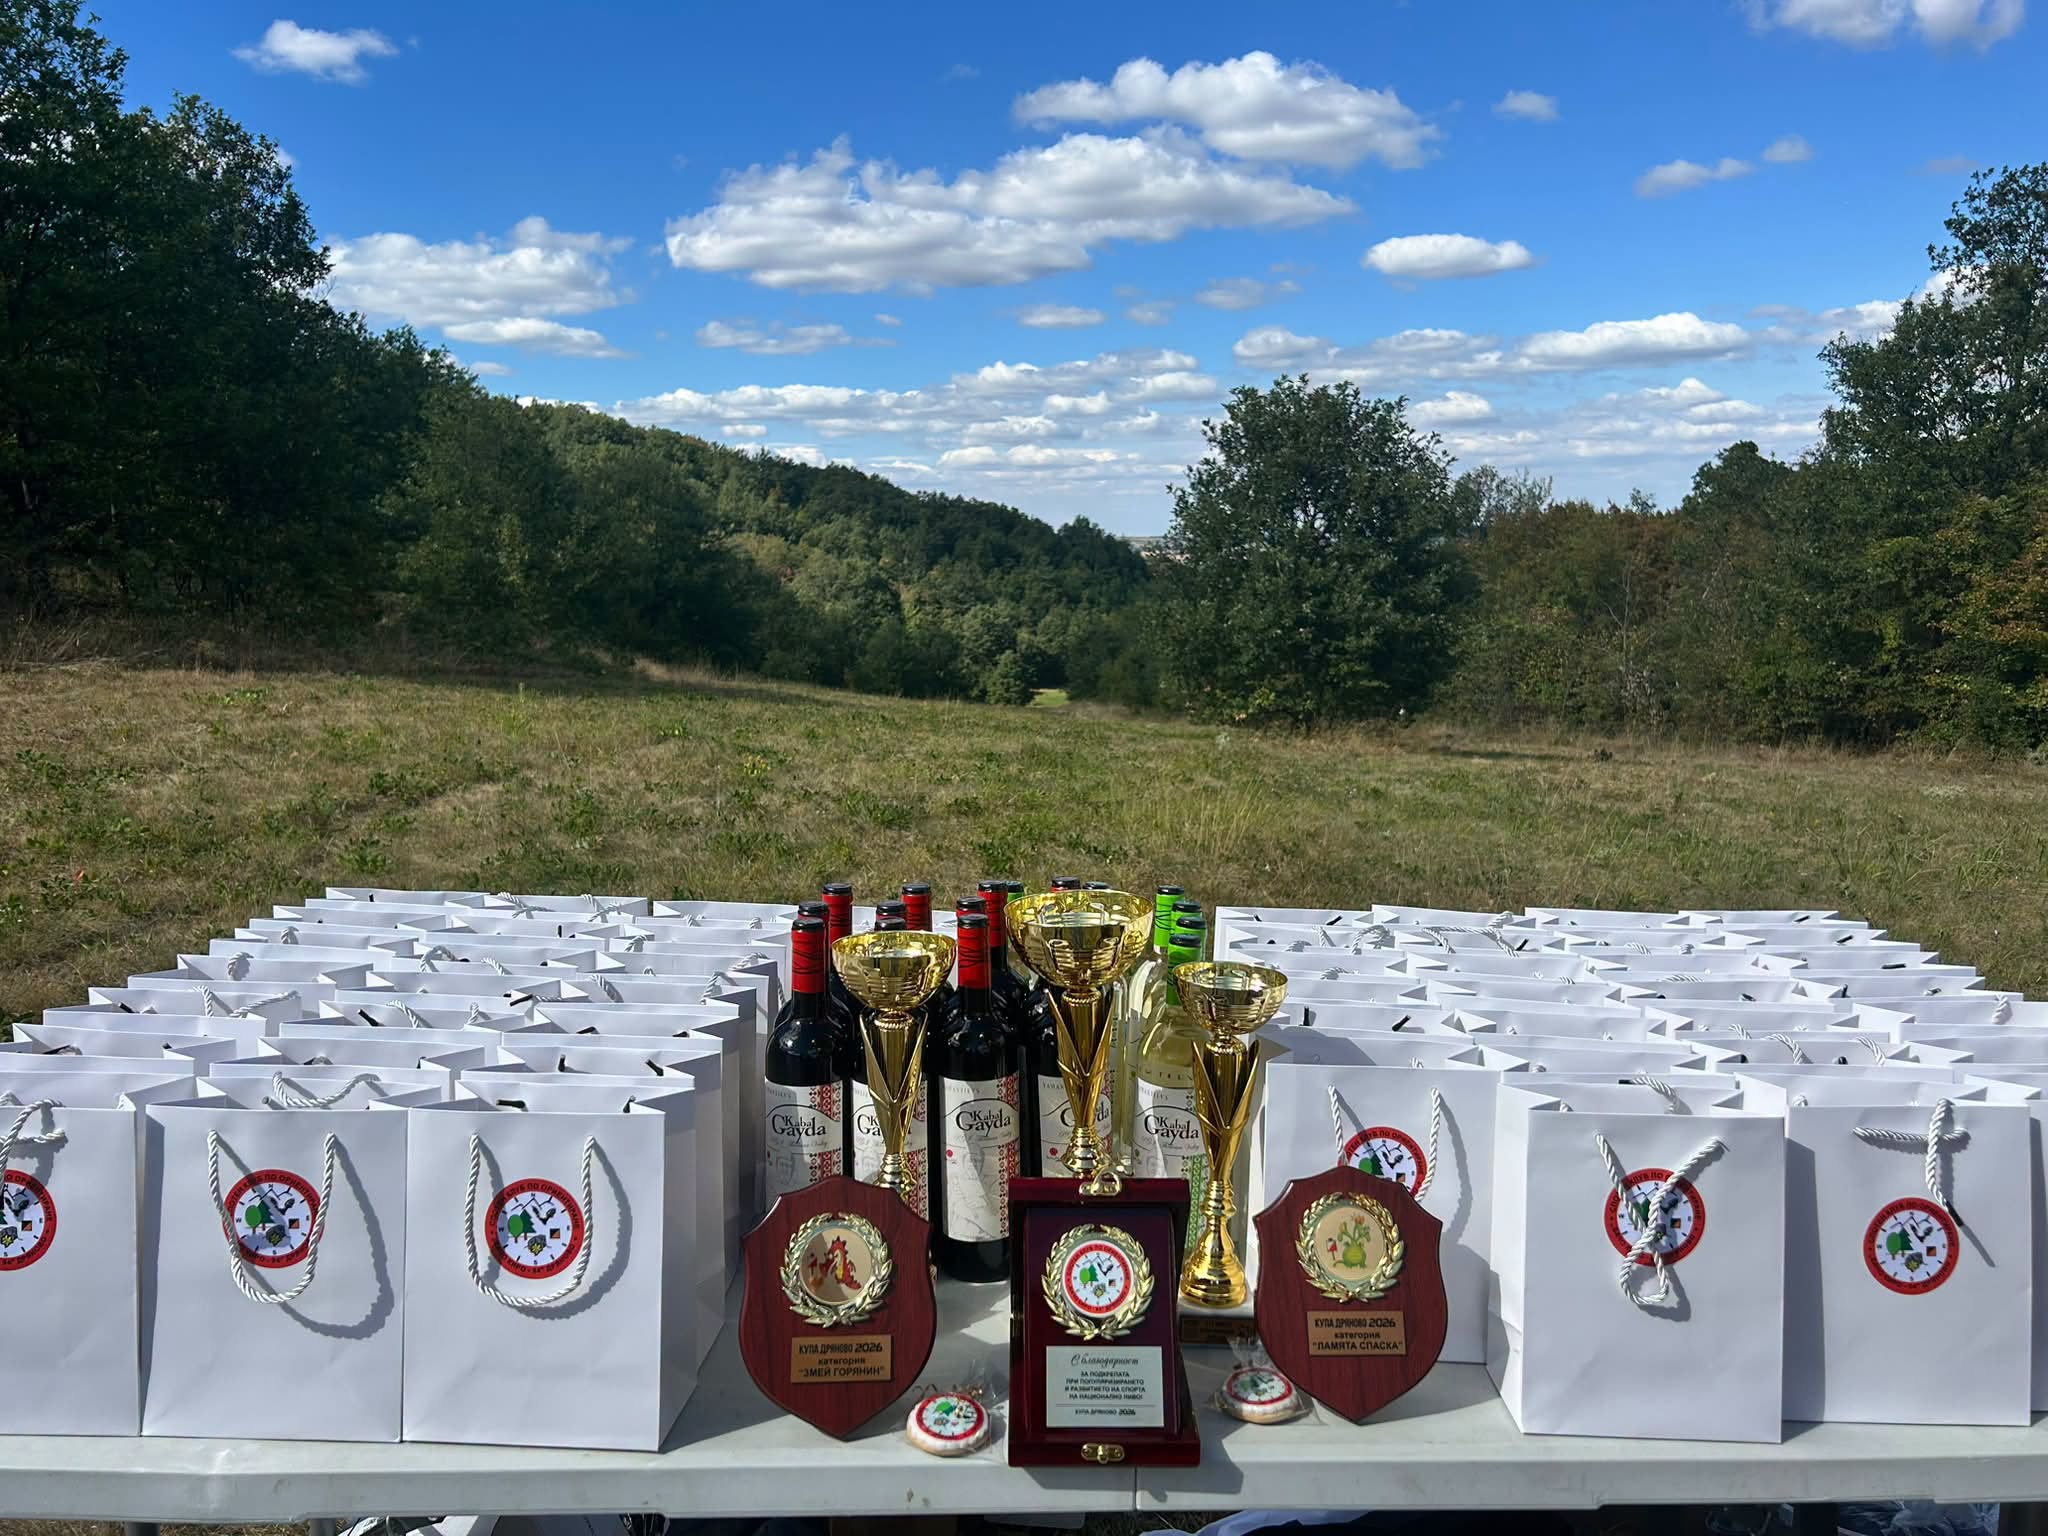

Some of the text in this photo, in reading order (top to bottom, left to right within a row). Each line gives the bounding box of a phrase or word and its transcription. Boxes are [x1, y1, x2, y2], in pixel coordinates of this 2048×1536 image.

[785, 1114, 812, 1127] Kaba
[972, 1109, 1000, 1121] Kaba
[1060, 1102, 1110, 1128] Gda
[771, 1113, 826, 1144] Gayda
[955, 1107, 1011, 1138] Gayda
[1159, 1116, 1187, 1130] Kaba
[1144, 1113, 1200, 1146] Gayda
[527, 1182, 540, 1190] ПО
[1314, 1318, 1334, 1328] КУПА
[1368, 1318, 1396, 1328] 2026
[1334, 1332, 1381, 1340] категория
[799, 1342, 883, 1354] КУПА ДРЯНОВО 2026
[818, 1357, 866, 1366] категория
[1118, 1408, 1136, 1416] 2026
